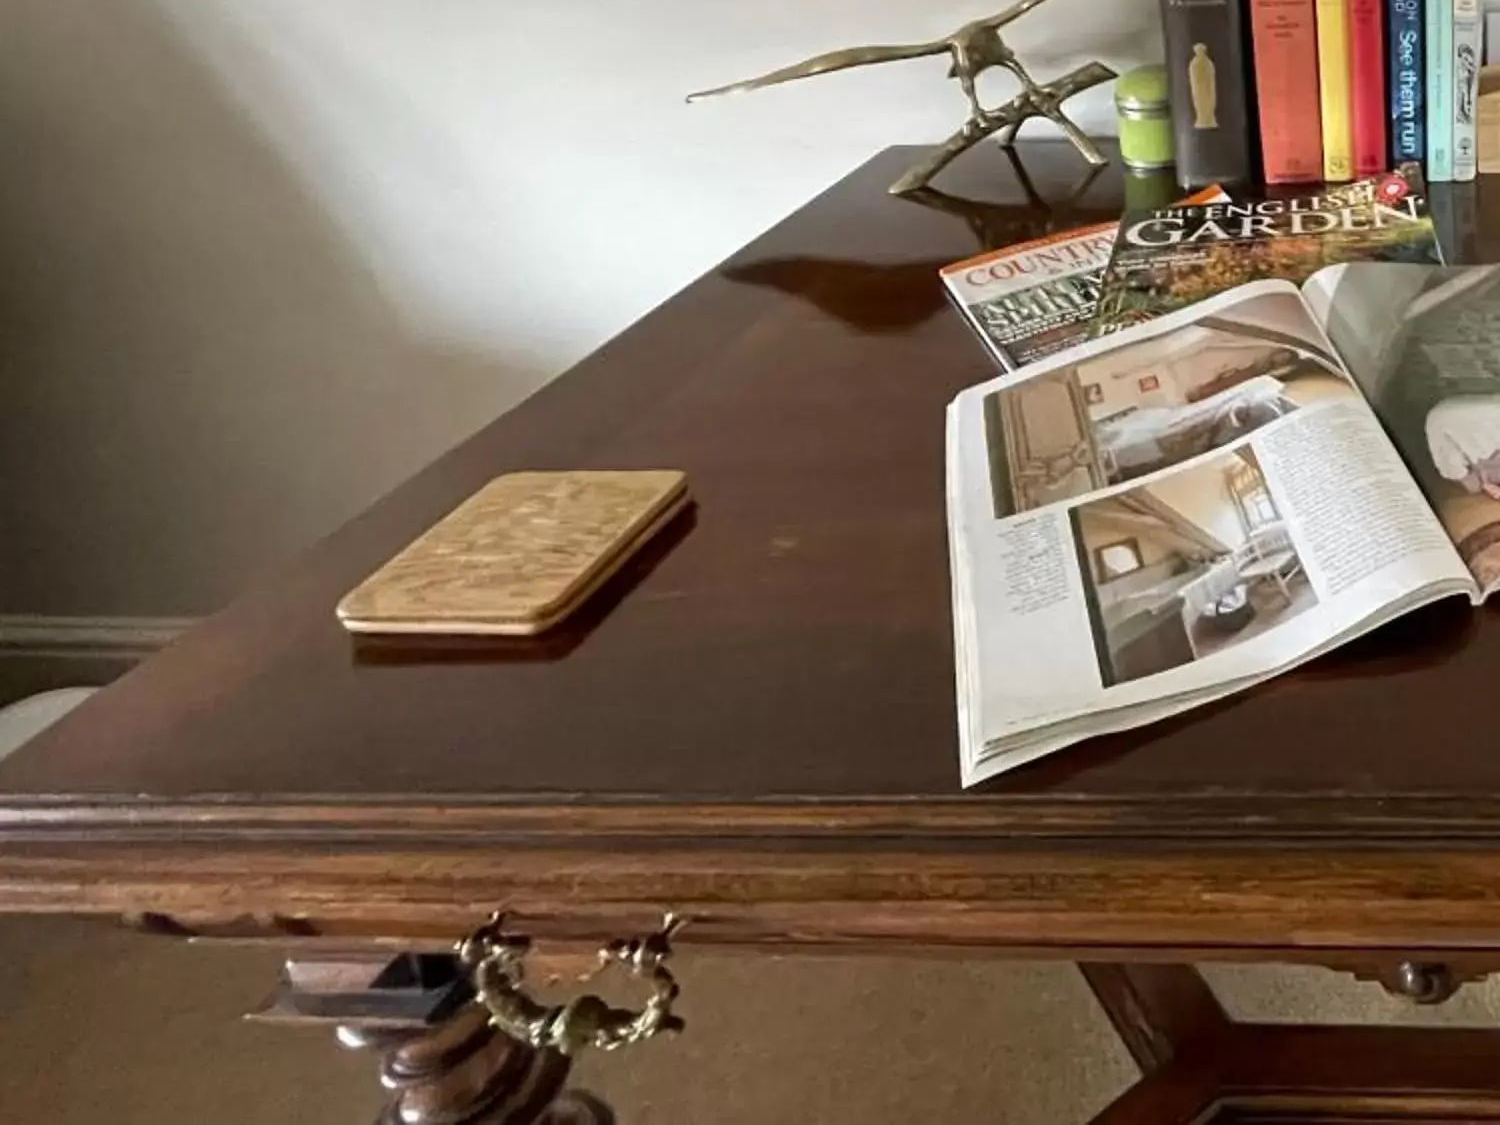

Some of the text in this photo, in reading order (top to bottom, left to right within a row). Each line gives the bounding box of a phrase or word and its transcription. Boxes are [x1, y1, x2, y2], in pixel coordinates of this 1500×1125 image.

[1400, 30, 1417, 155] See them run
[1126, 195, 1421, 246] GARDEN
[1153, 180, 1374, 221] THE ENGLISH
[966, 235, 1113, 286] COUNTRY
